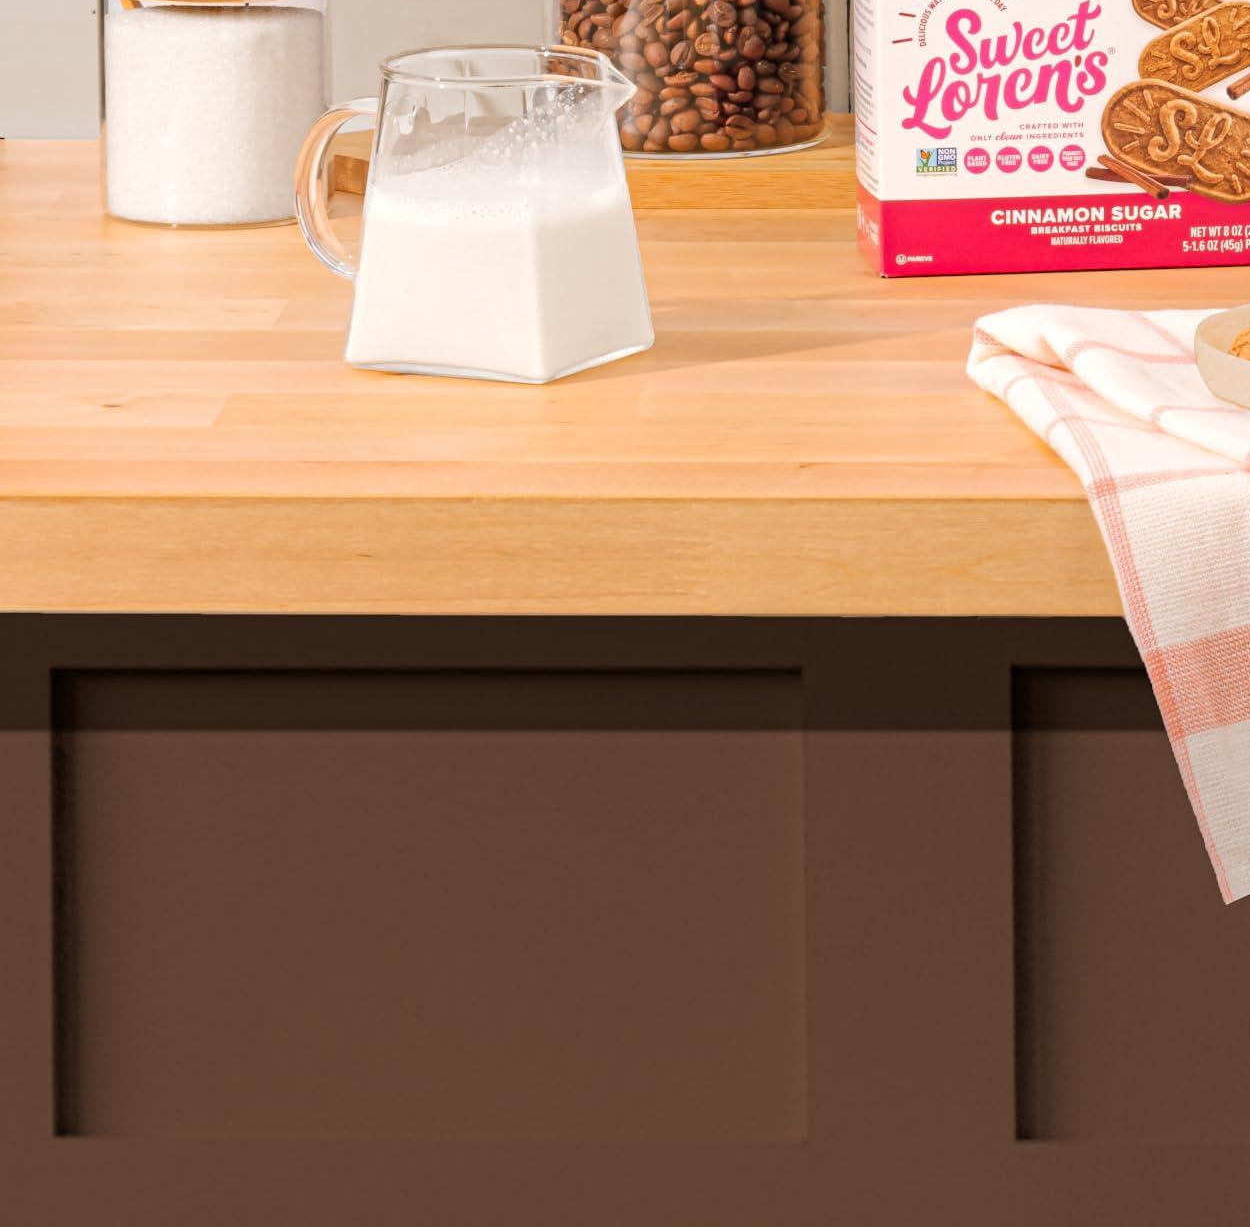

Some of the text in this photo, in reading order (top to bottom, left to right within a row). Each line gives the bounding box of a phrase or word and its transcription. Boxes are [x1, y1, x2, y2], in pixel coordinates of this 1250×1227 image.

[918, 9, 932, 47] DELICIOUS
[945, 0, 1102, 75] Sweet
[1019, 122, 1059, 130] CRAFTED
[995, 131, 1024, 141] clean
[1026, 132, 1084, 140] INGREDIENTS
[990, 204, 1182, 225] CINNAMON SUGAR
[1030, 223, 1143, 235] BREAKFAST BISCUITS
[1190, 226, 1207, 237] NET
[1208, 225, 1222, 237] WT
[1223, 225, 1230, 237] 8
[1231, 225, 1243, 236] OZ
[1050, 234, 1124, 246] NATURALLY FLAVORED
[1182, 240, 1206, 252] 5-1.6
[1207, 240, 1218, 251] OZ
[1220, 238, 1243, 253] (45g)
